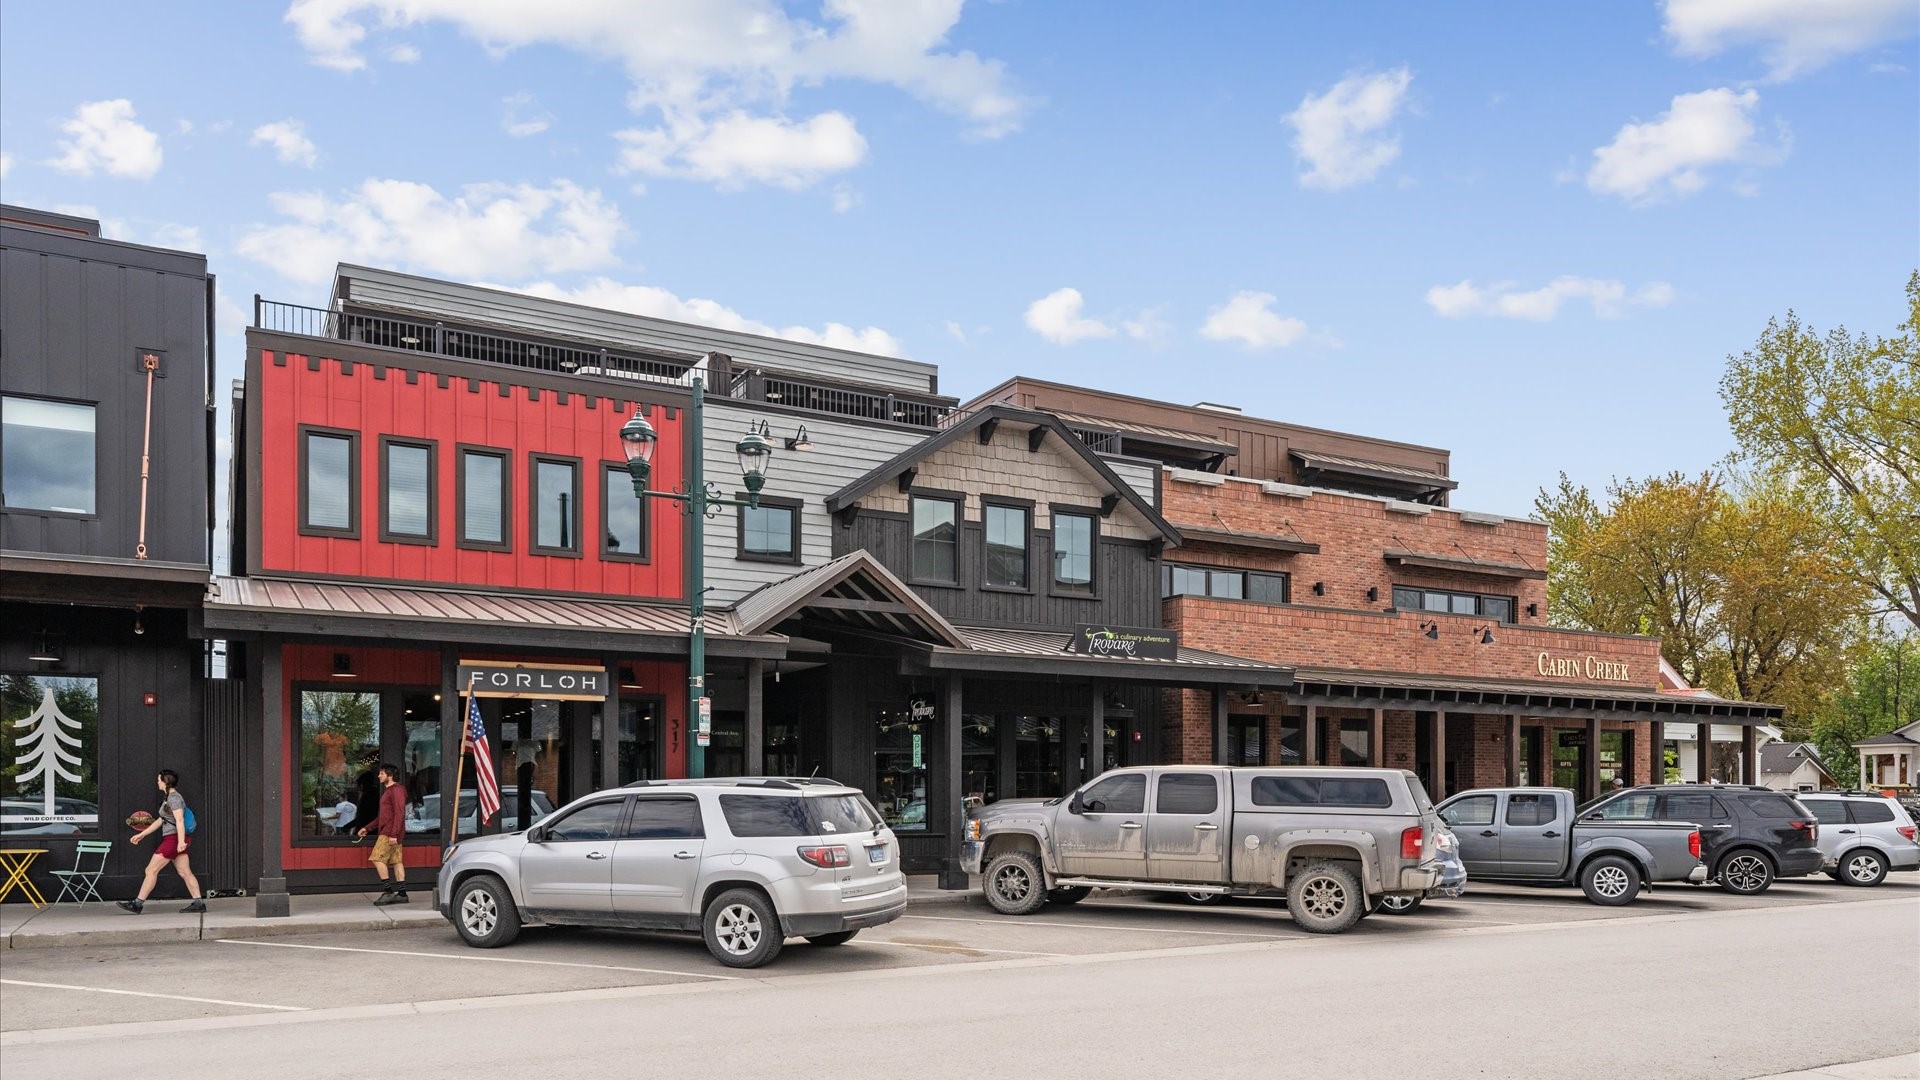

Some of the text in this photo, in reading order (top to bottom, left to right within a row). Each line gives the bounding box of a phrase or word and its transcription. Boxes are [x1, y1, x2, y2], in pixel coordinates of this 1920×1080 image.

[1120, 634, 1141, 642] culinary
[1143, 635, 1170, 643] adventure
[1538, 652, 1630, 681] CABIN CREEK
[471, 671, 596, 690] FORLOH
[672, 719, 680, 753] 317
